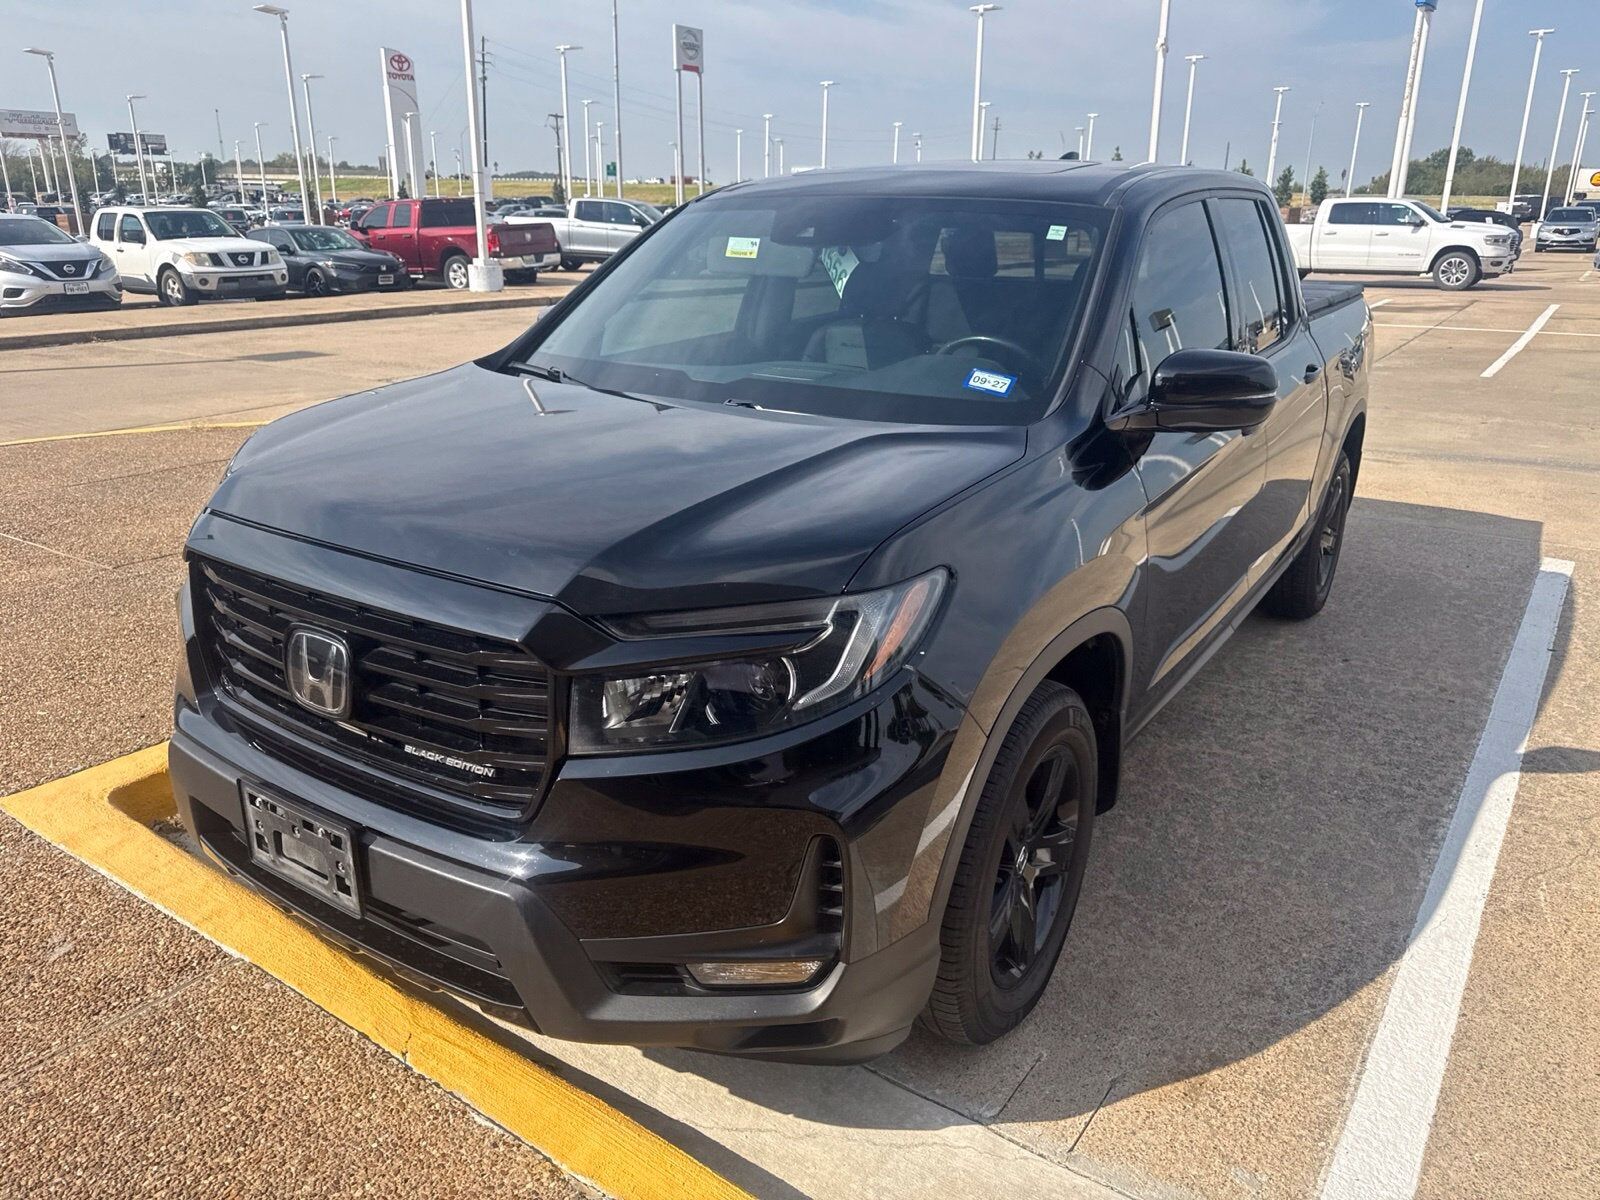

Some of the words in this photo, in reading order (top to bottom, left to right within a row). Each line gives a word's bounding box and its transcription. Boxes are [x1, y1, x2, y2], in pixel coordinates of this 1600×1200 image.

[387, 72, 415, 81] TOYOTA
[991, 380, 1008, 389] 27
[404, 744, 445, 763] BLACK
[445, 757, 496, 777] EDITION
